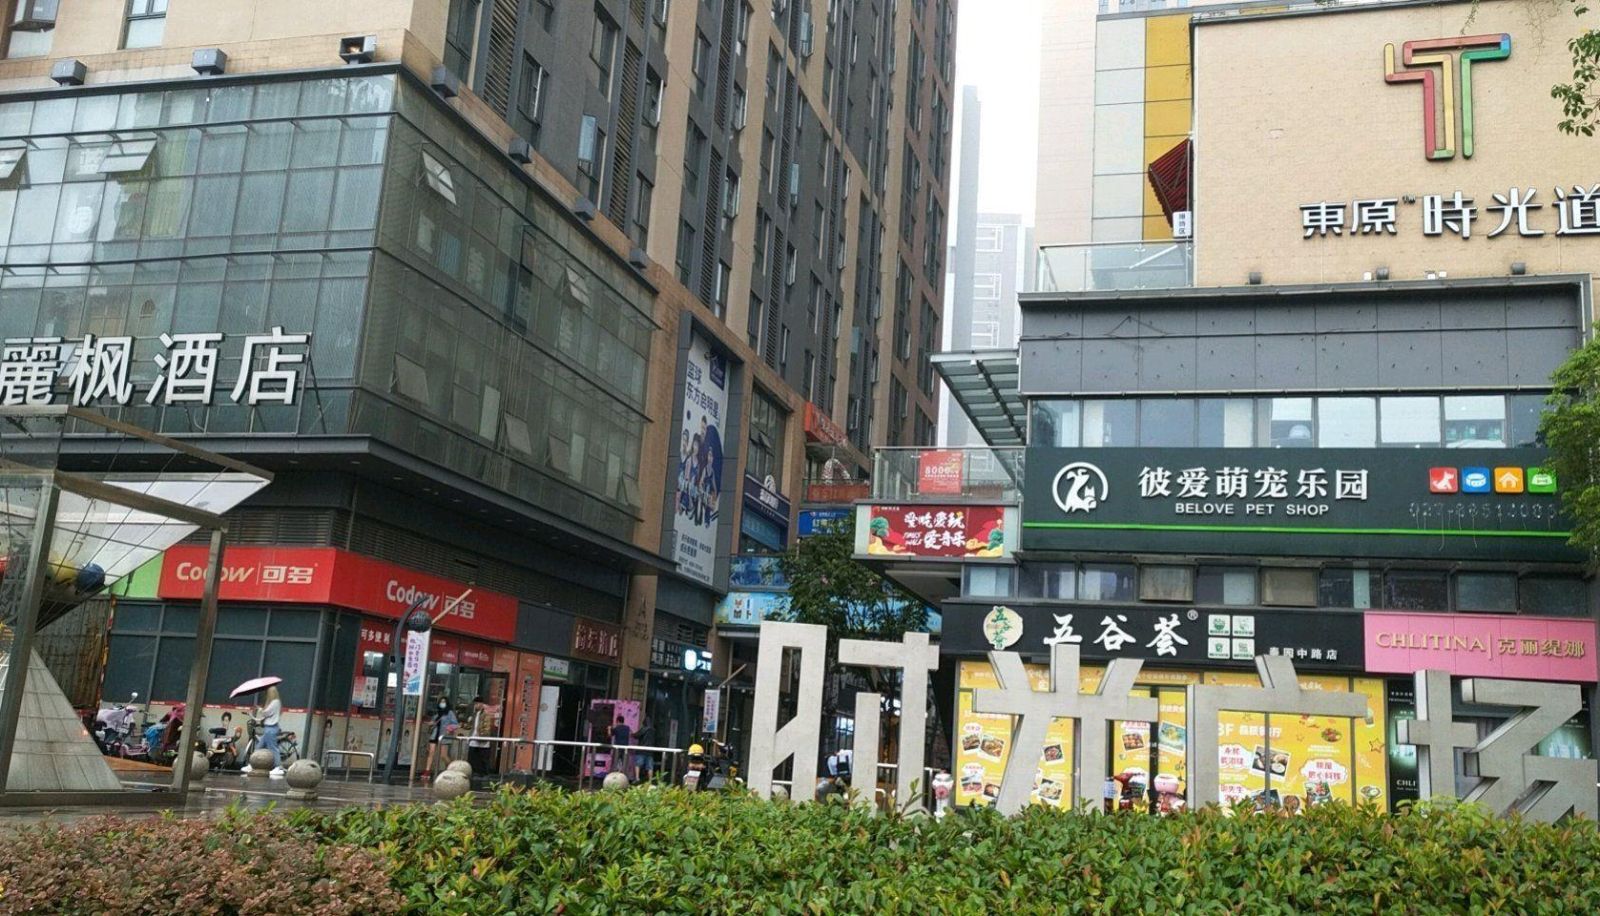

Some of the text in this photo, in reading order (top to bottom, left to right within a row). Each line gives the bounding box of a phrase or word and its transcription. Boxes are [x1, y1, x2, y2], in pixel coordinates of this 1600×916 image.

[1423, 183, 1600, 240] 時光道
[0, 325, 311, 405] 麗枫酒店
[1138, 466, 1369, 500] 彼爱萌宠乐园
[1175, 502, 1329, 516] BELOVE PET SHOP
[176, 561, 315, 584] Coow 可多
[1043, 612, 1189, 656] 五谷荟
[1375, 632, 1585, 660] CHLITINA 克丽缇娜
[1396, 779, 1416, 787] CHLI
